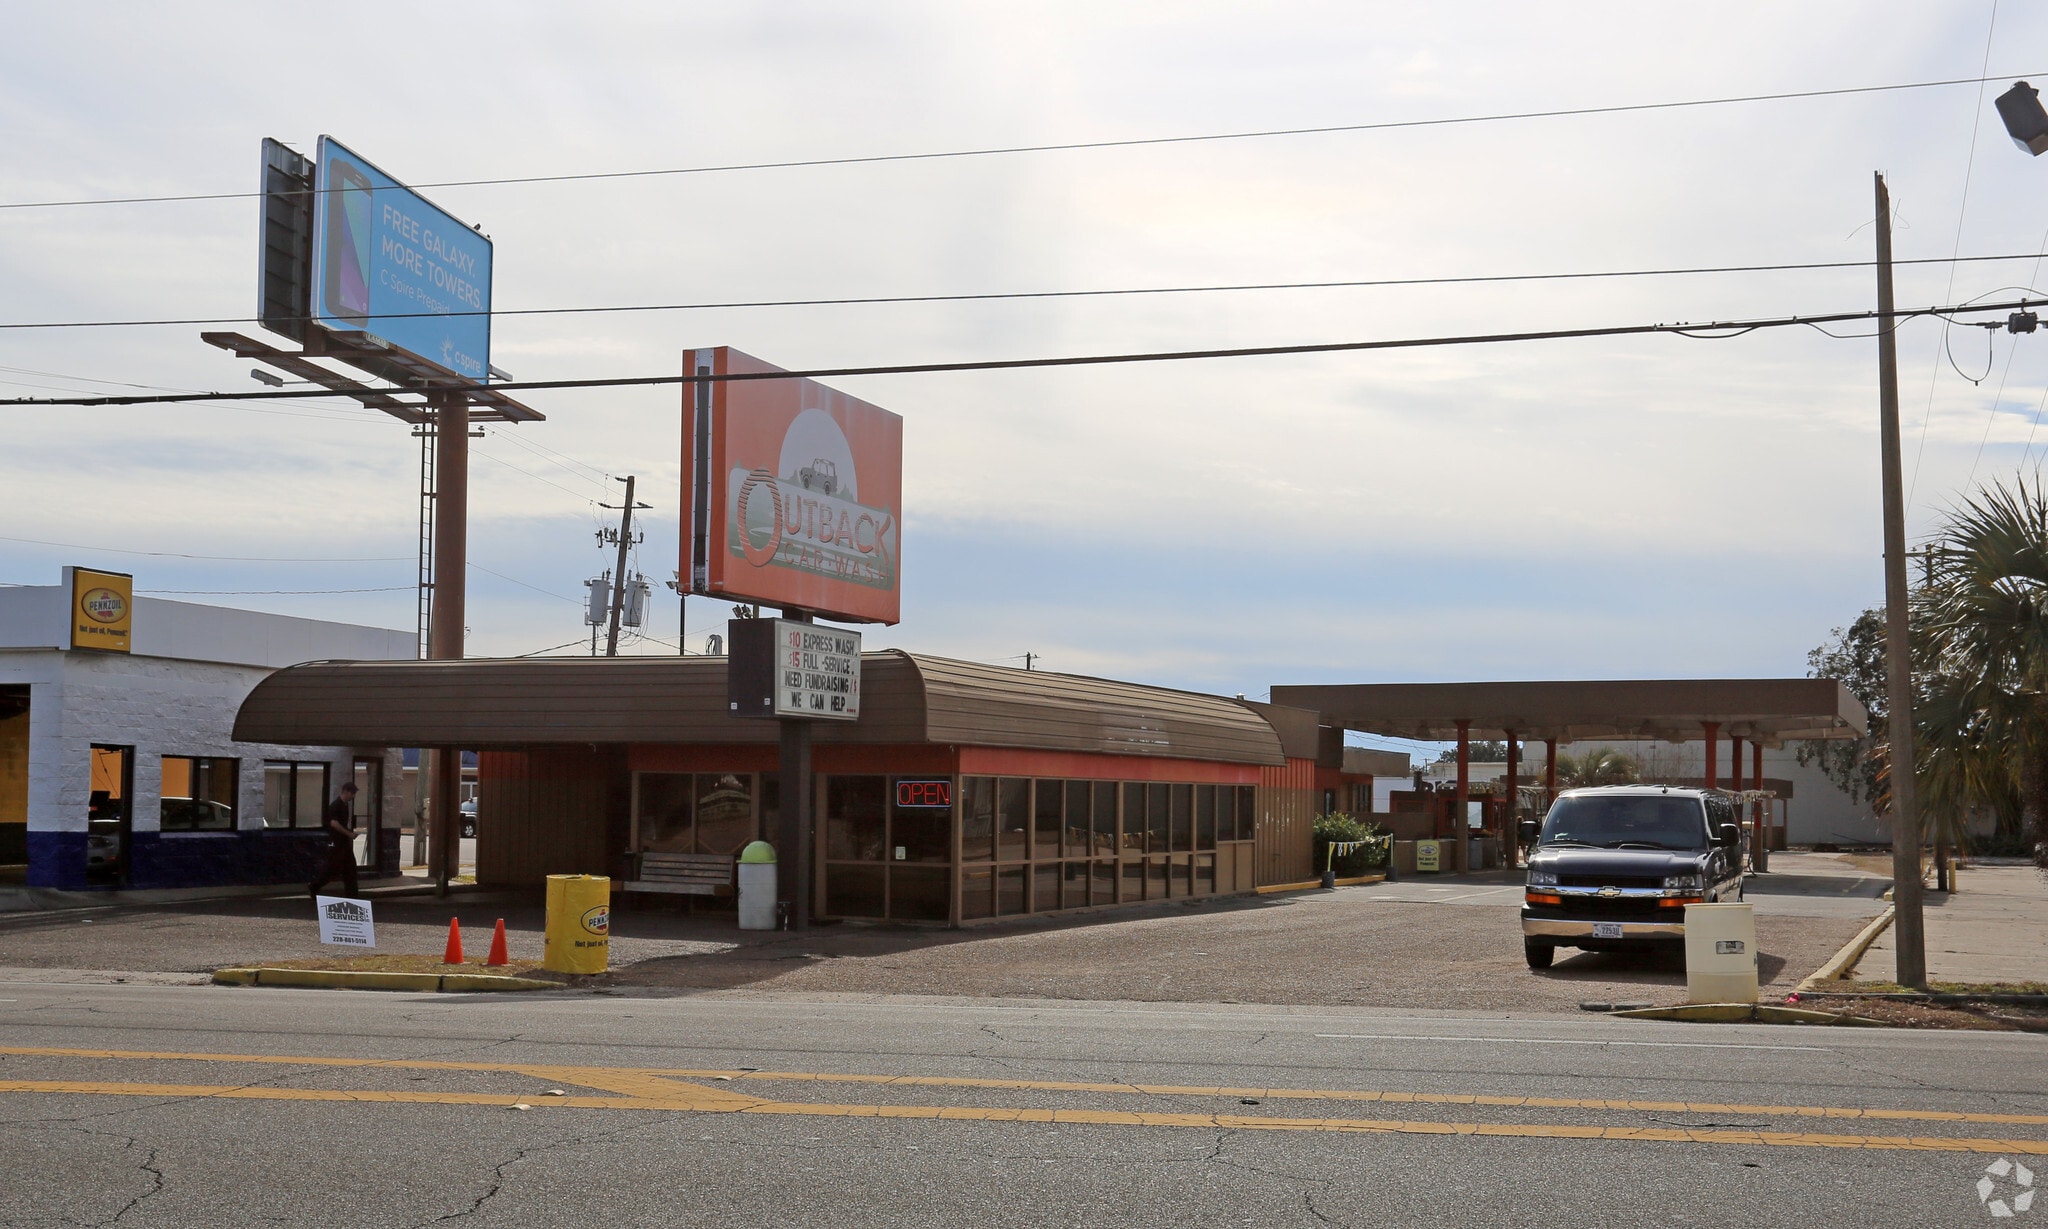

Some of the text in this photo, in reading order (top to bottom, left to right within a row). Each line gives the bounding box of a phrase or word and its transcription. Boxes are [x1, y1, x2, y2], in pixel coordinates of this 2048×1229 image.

[383, 204, 475, 279] FREE GALAXY.
[382, 235, 483, 310] MORE TOWERS.
[380, 269, 451, 319] C Spire Prepaid
[737, 469, 891, 568] OUTBACK
[89, 600, 122, 611] PENNZOIL
[789, 631, 800, 648] $10
[803, 633, 833, 652] EXPRESS
[789, 651, 800, 667] $15
[803, 653, 818, 670] FULL
[785, 670, 802, 688] NEED
[791, 692, 801, 708] WE
[810, 694, 824, 710] CAN
[899, 783, 950, 805] OPEN
[327, 912, 365, 922] SERVICES
